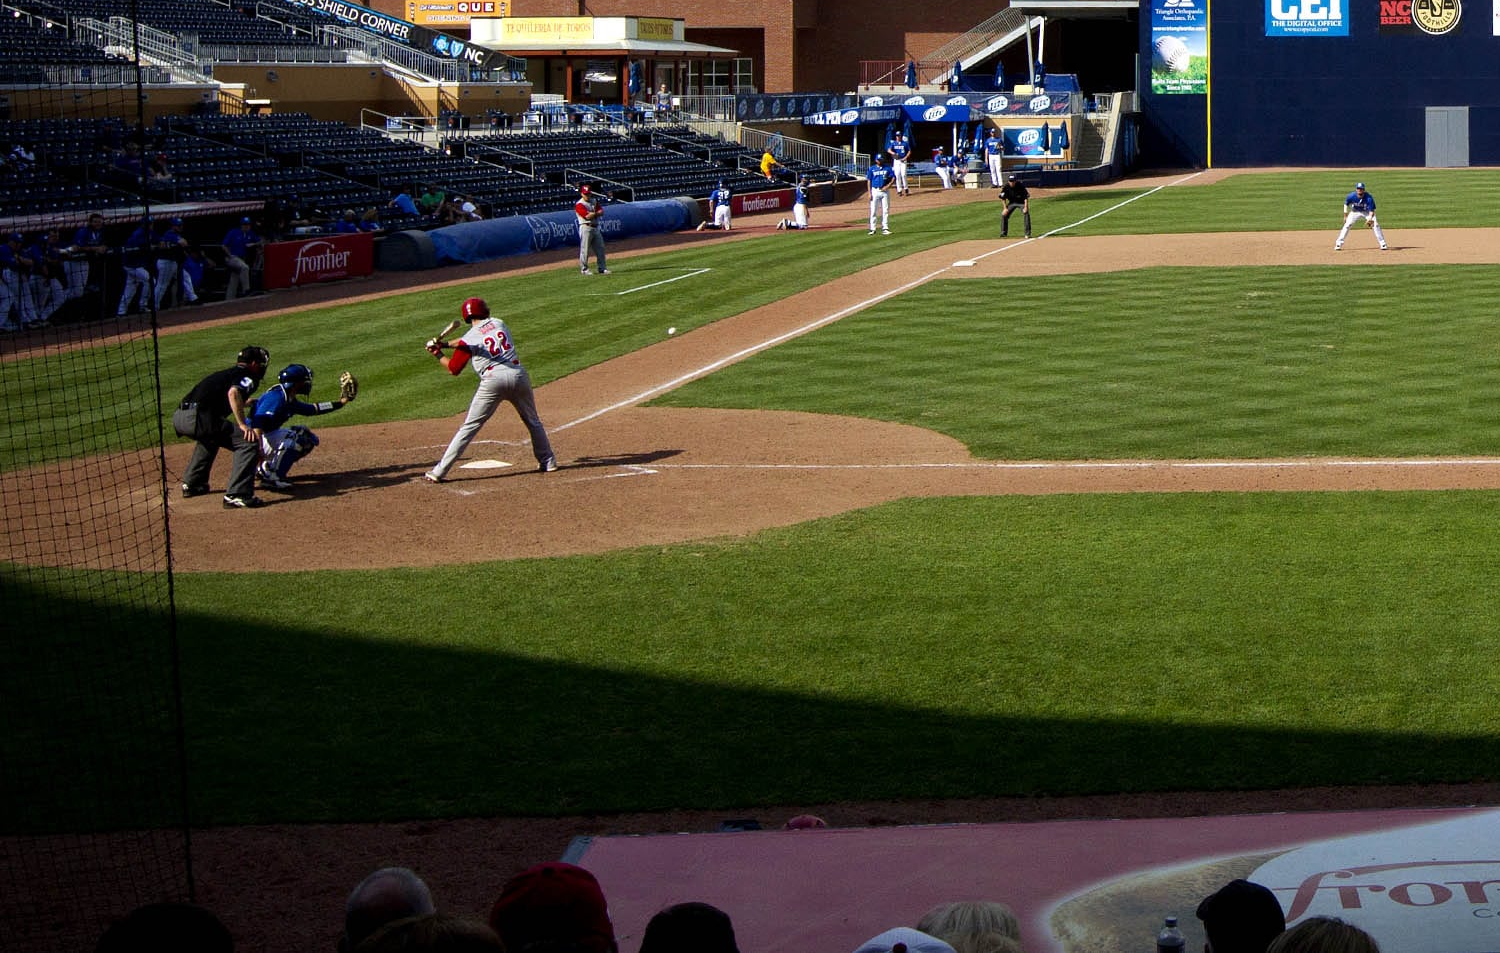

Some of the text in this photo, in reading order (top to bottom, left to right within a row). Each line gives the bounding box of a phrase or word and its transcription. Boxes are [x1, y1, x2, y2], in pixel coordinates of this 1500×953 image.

[458, 2, 494, 12] QUE
[1380, 0, 1411, 16] NC
[360, 12, 409, 39] CORNER
[1380, 16, 1411, 25] BEER
[1420, 11, 1453, 26] FOOTHILLS
[464, 47, 484, 65] NC
[803, 113, 825, 126] BULL
[825, 111, 841, 125] PEN
[742, 196, 780, 211] frontier.com
[550, 221, 575, 241] Bayer
[292, 241, 351, 283] frontier
[483, 330, 513, 358] 22
